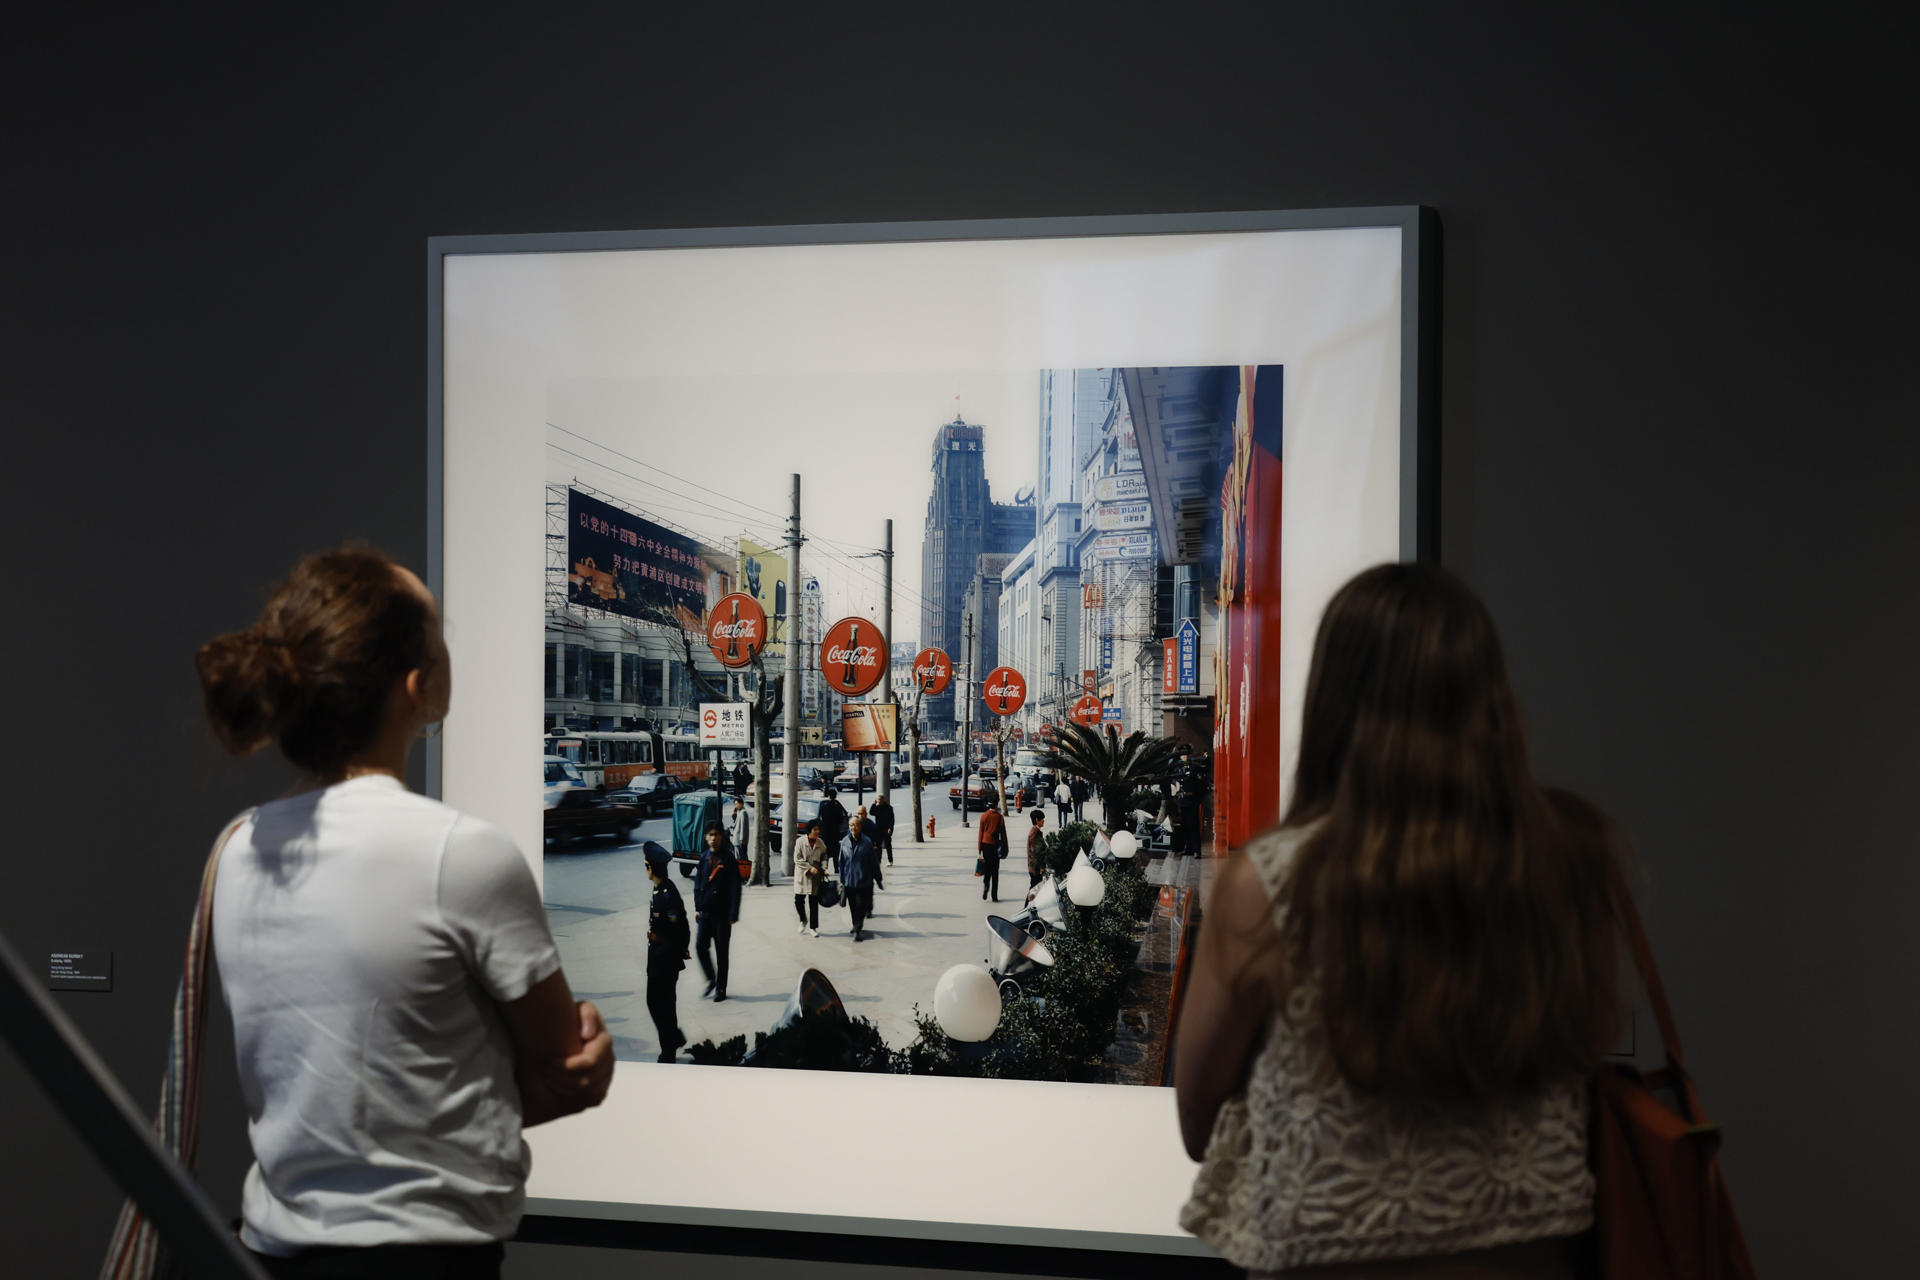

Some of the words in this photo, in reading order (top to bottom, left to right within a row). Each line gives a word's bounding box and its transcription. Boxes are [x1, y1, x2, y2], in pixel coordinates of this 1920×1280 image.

[712, 619, 757, 640] Coca-Cola
[827, 644, 877, 667] Coca-Cola
[988, 684, 1021, 698] Coca-Cola
[721, 709, 744, 721] 地铁
